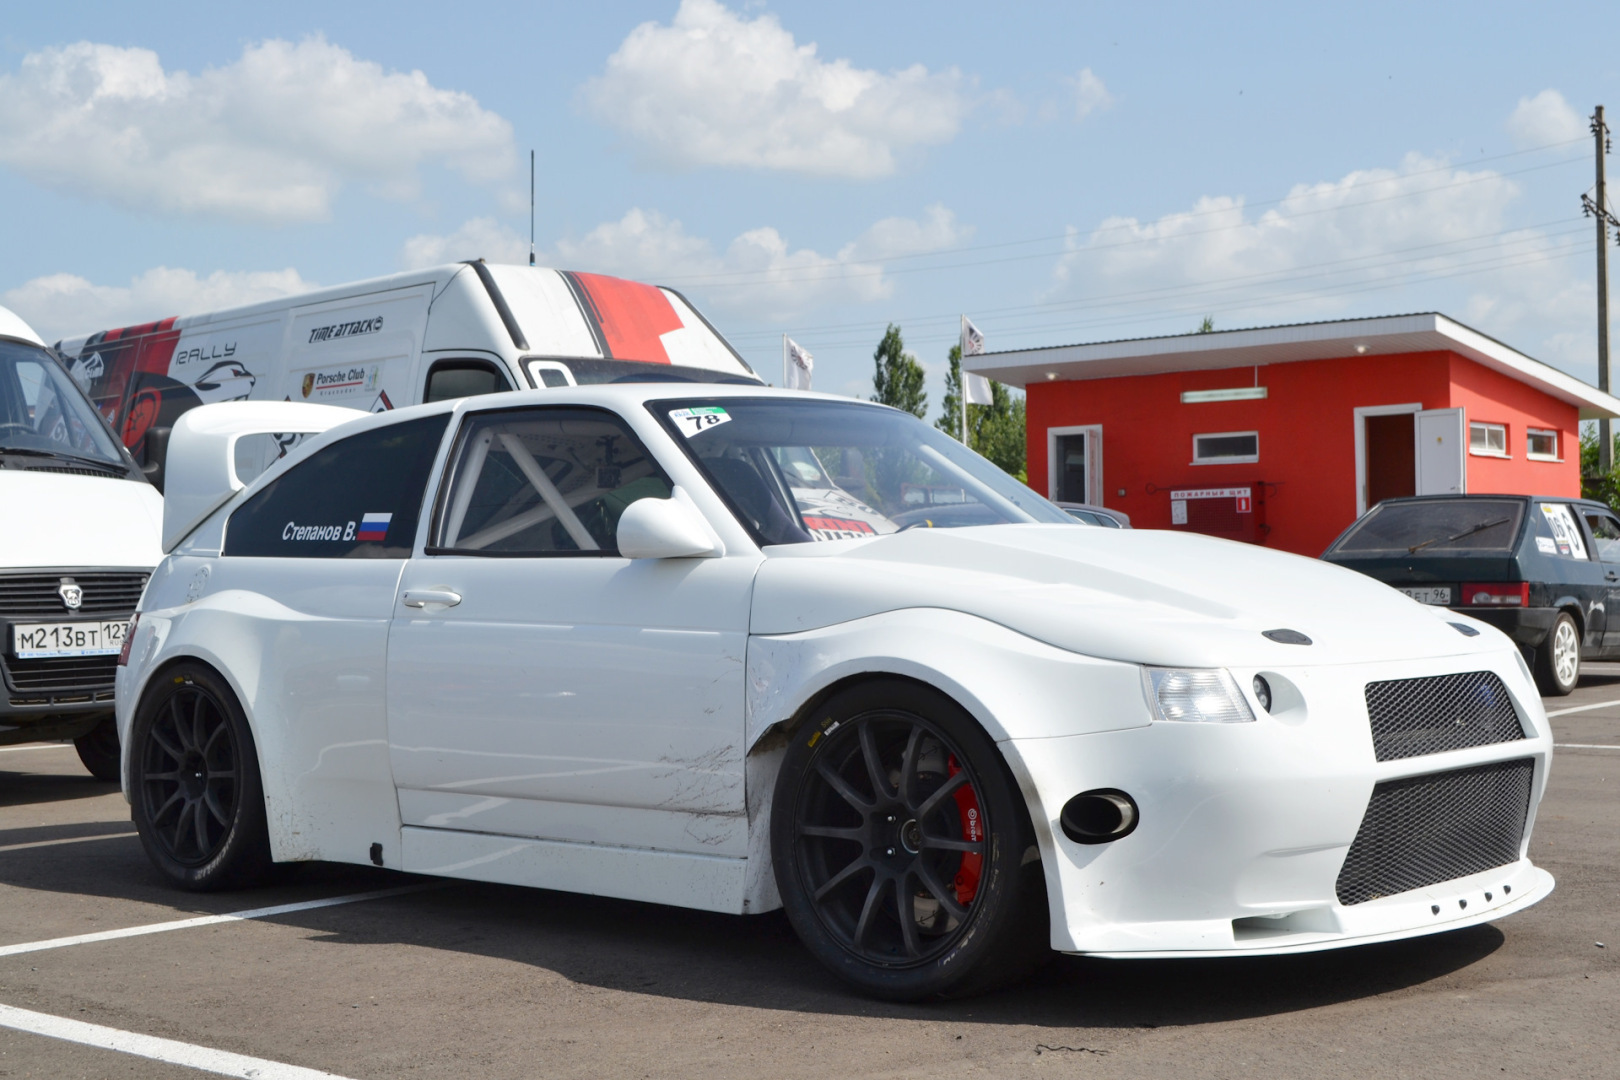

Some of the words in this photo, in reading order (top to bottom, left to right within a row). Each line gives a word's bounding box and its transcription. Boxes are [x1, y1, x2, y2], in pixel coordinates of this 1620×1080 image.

[175, 341, 237, 365] RALLY
[316, 371, 346, 385] Porsche
[347, 367, 366, 381] Club
[686, 415, 720, 431] 78
[282, 521, 342, 541] Степанов
